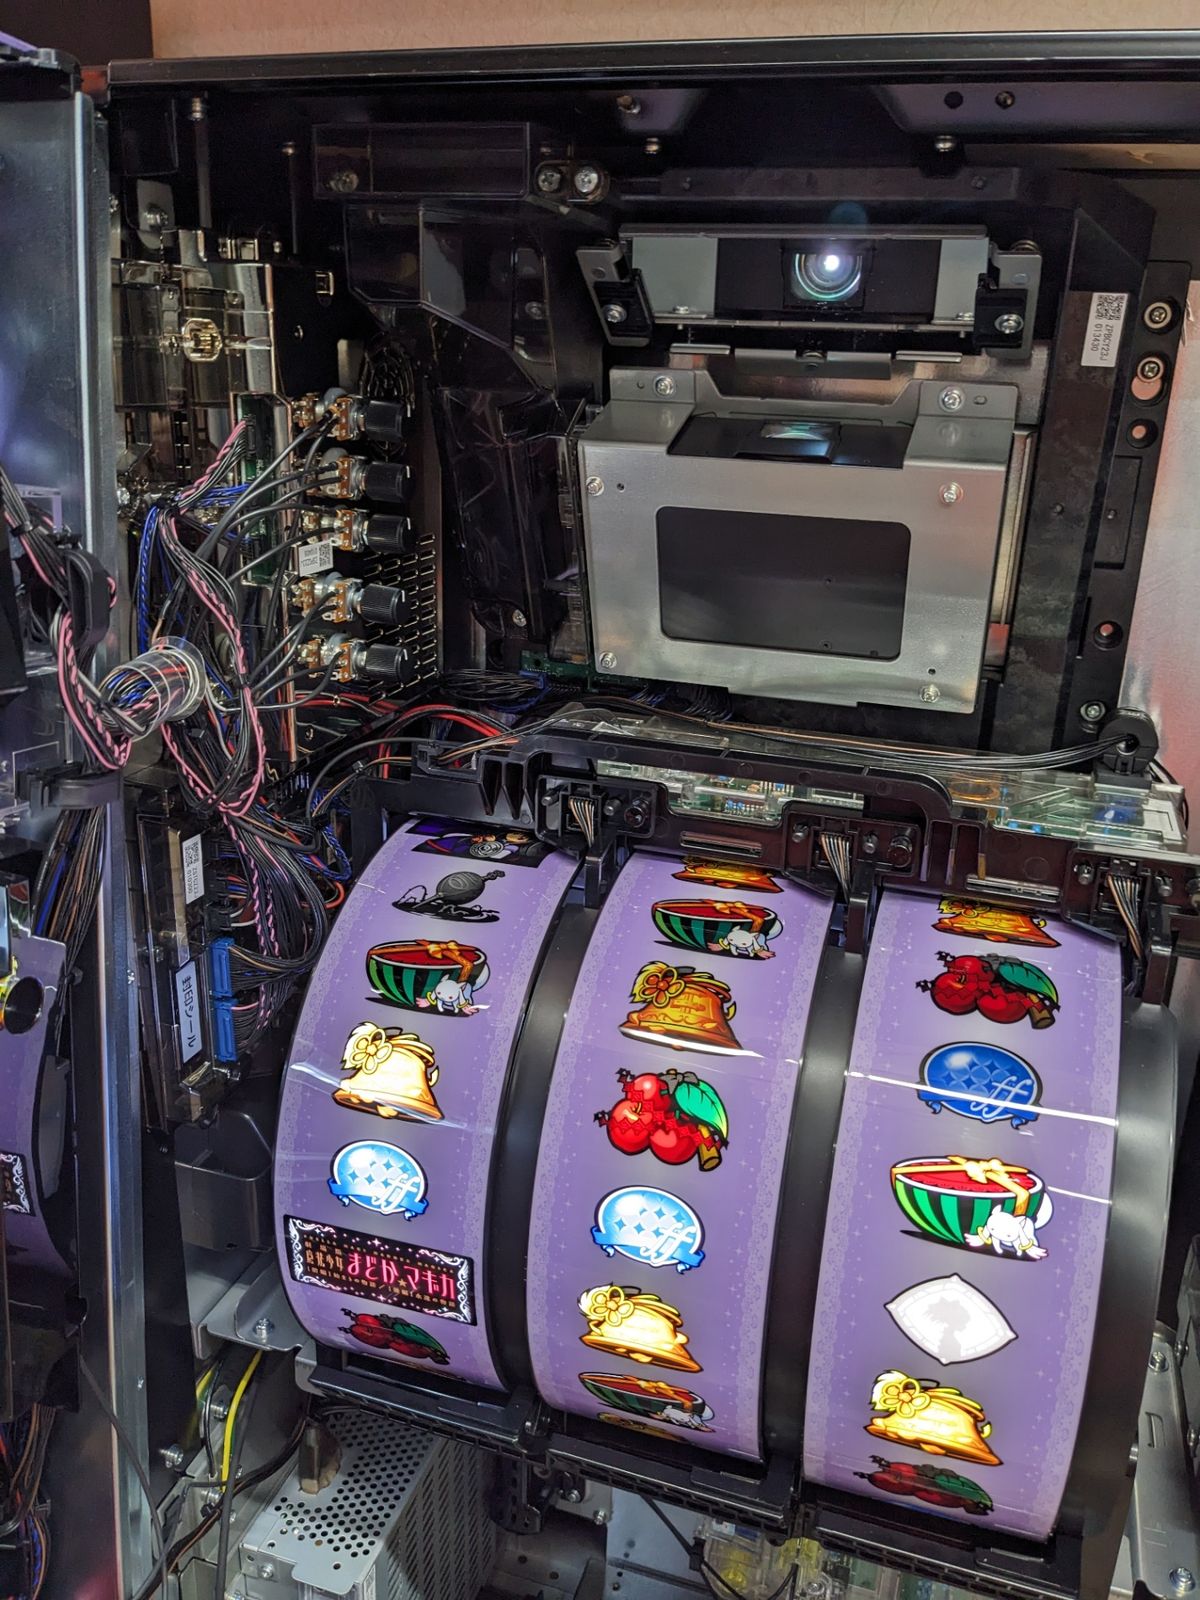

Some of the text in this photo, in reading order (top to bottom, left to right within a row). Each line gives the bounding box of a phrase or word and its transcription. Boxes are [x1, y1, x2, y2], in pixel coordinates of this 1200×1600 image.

[181, 975, 197, 1048] 封印シール
